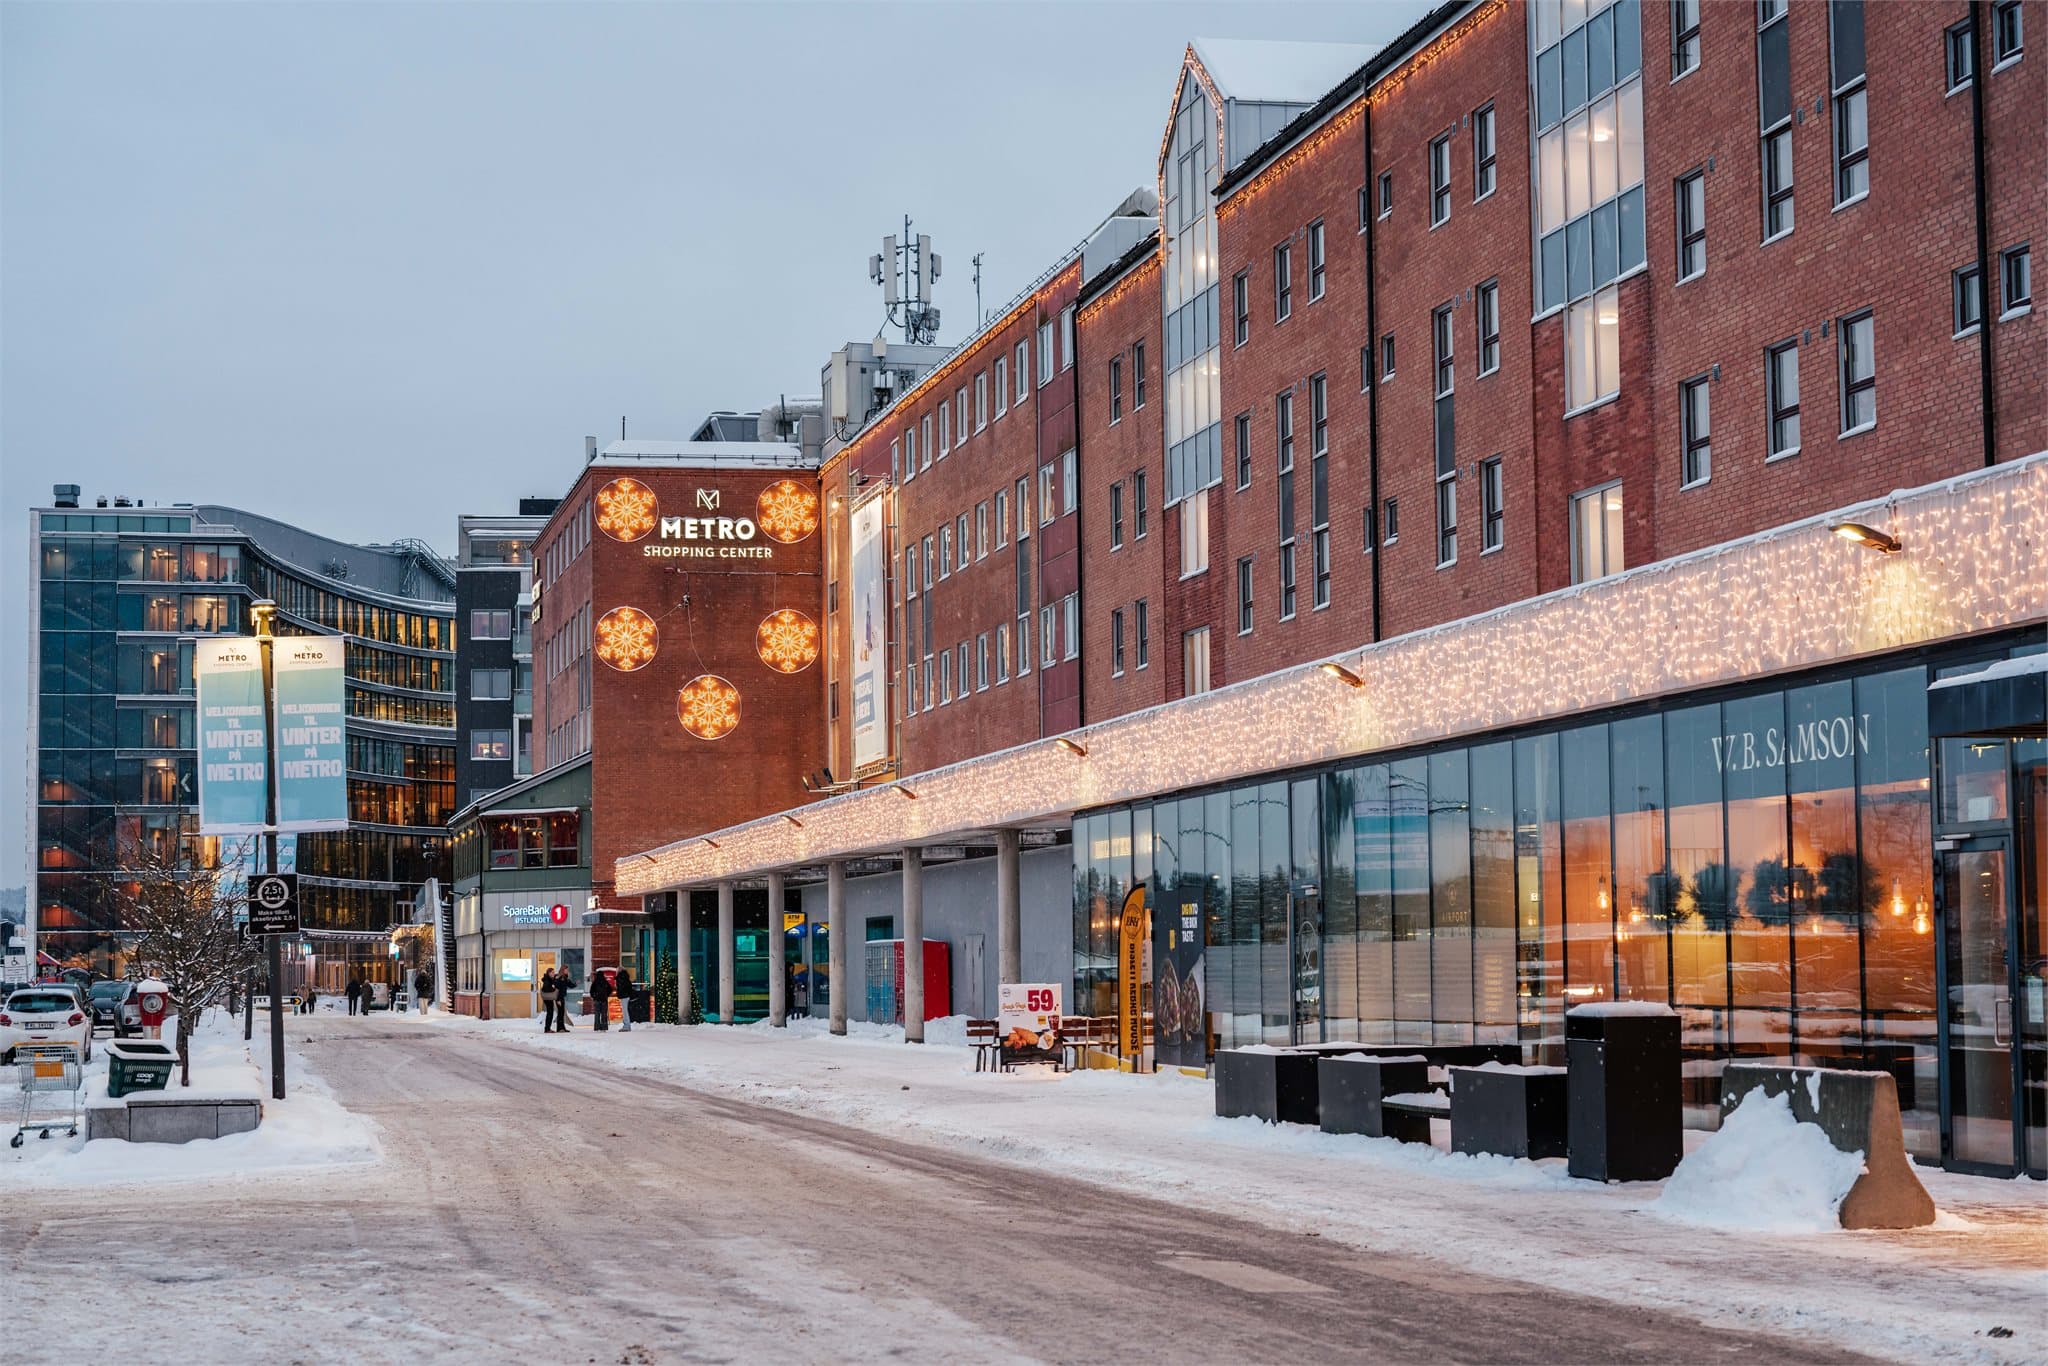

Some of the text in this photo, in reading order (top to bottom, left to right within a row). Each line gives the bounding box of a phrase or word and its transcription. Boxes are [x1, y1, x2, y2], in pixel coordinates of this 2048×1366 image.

[660, 518, 756, 541] METRO
[643, 545, 773, 558] SHOPPING CENTER
[206, 706, 262, 716] VELKOMMEN
[282, 704, 340, 714] VELKOMMEN
[228, 719, 241, 728] TIL
[304, 716, 317, 725] TIL
[206, 730, 263, 748] VINTER
[282, 727, 341, 746] VINTER
[1742, 732, 1761, 770] B.
[1766, 714, 1870, 768] SAMSON
[207, 763, 264, 781] METRO
[284, 760, 341, 778] METRO
[503, 904, 562, 920] SpareBank 1
[515, 916, 551, 924] ØSTLANDET
